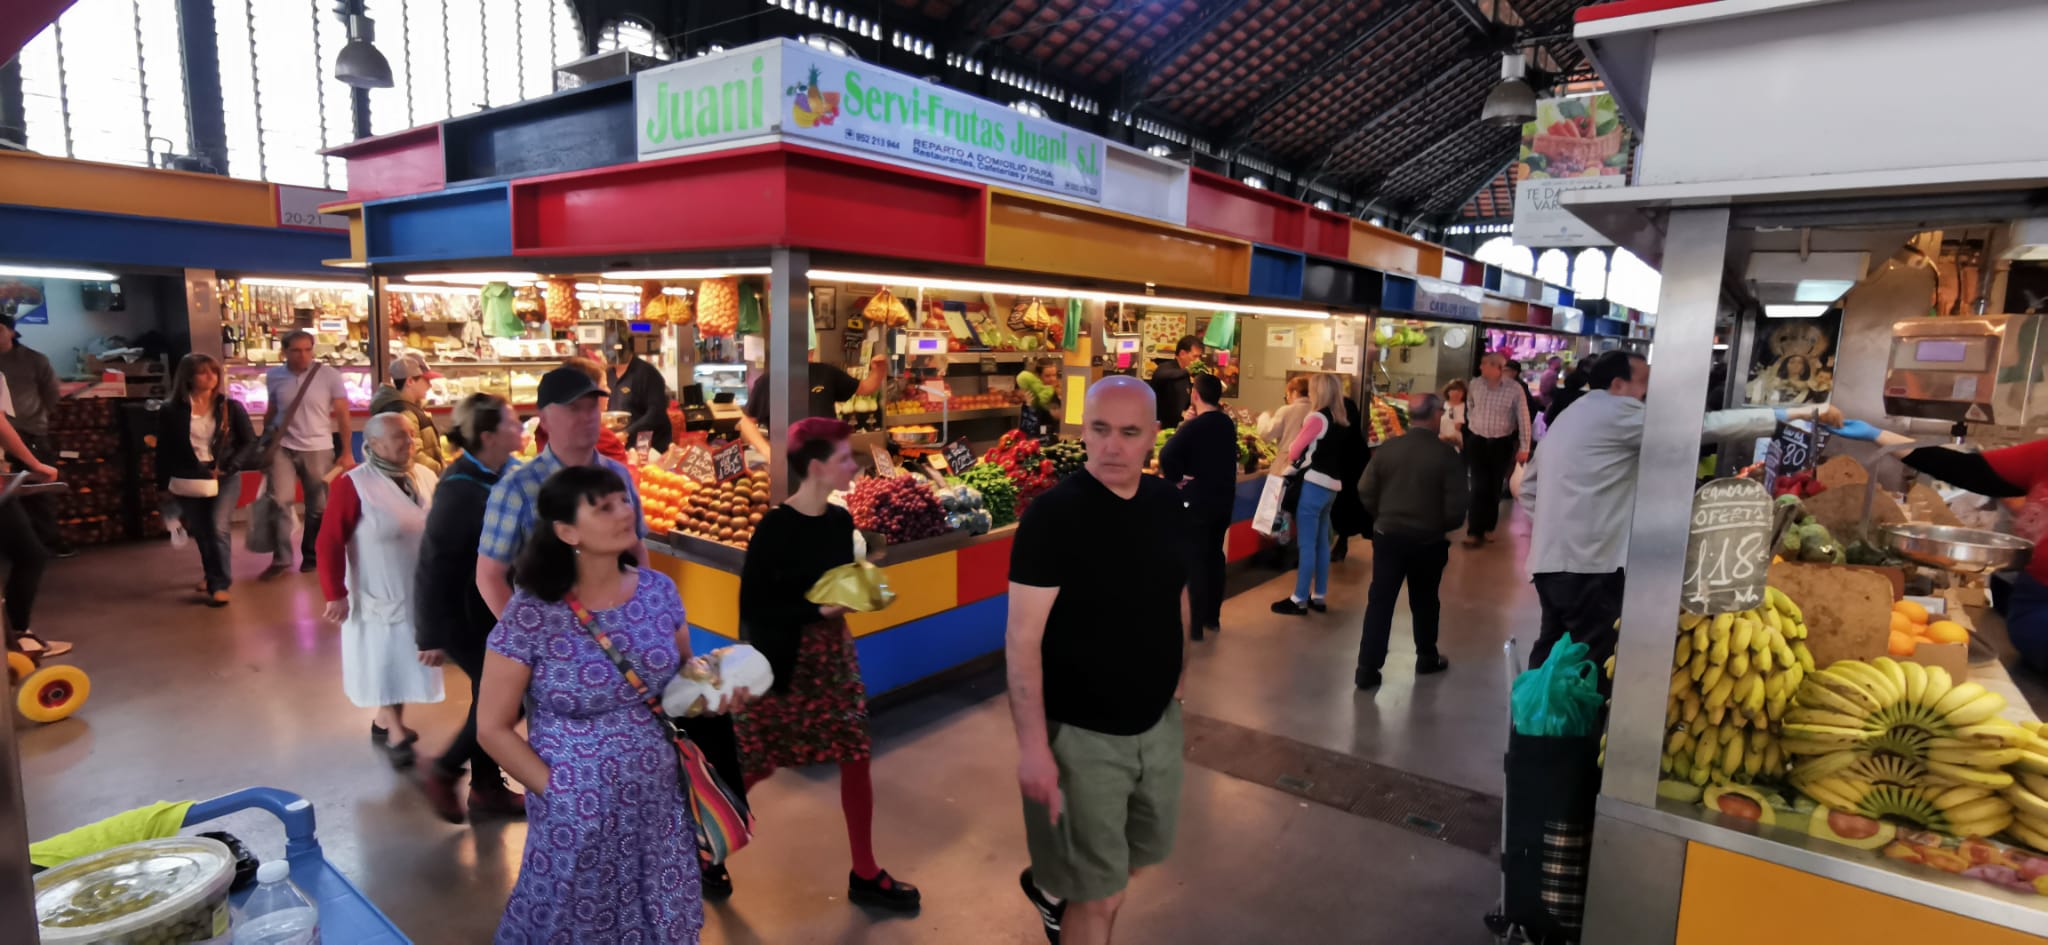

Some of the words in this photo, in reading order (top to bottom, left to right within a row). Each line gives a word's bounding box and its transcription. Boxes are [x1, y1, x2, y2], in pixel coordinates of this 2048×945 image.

[647, 56, 764, 144] Juani
[844, 70, 1005, 152] Servi-Frutas
[913, 139, 964, 158] REPARTO
[967, 152, 973, 160] A
[977, 154, 1028, 173] DOMICILIO
[1527, 188, 1540, 201] TE
[1695, 507, 1764, 526] OFERTA
